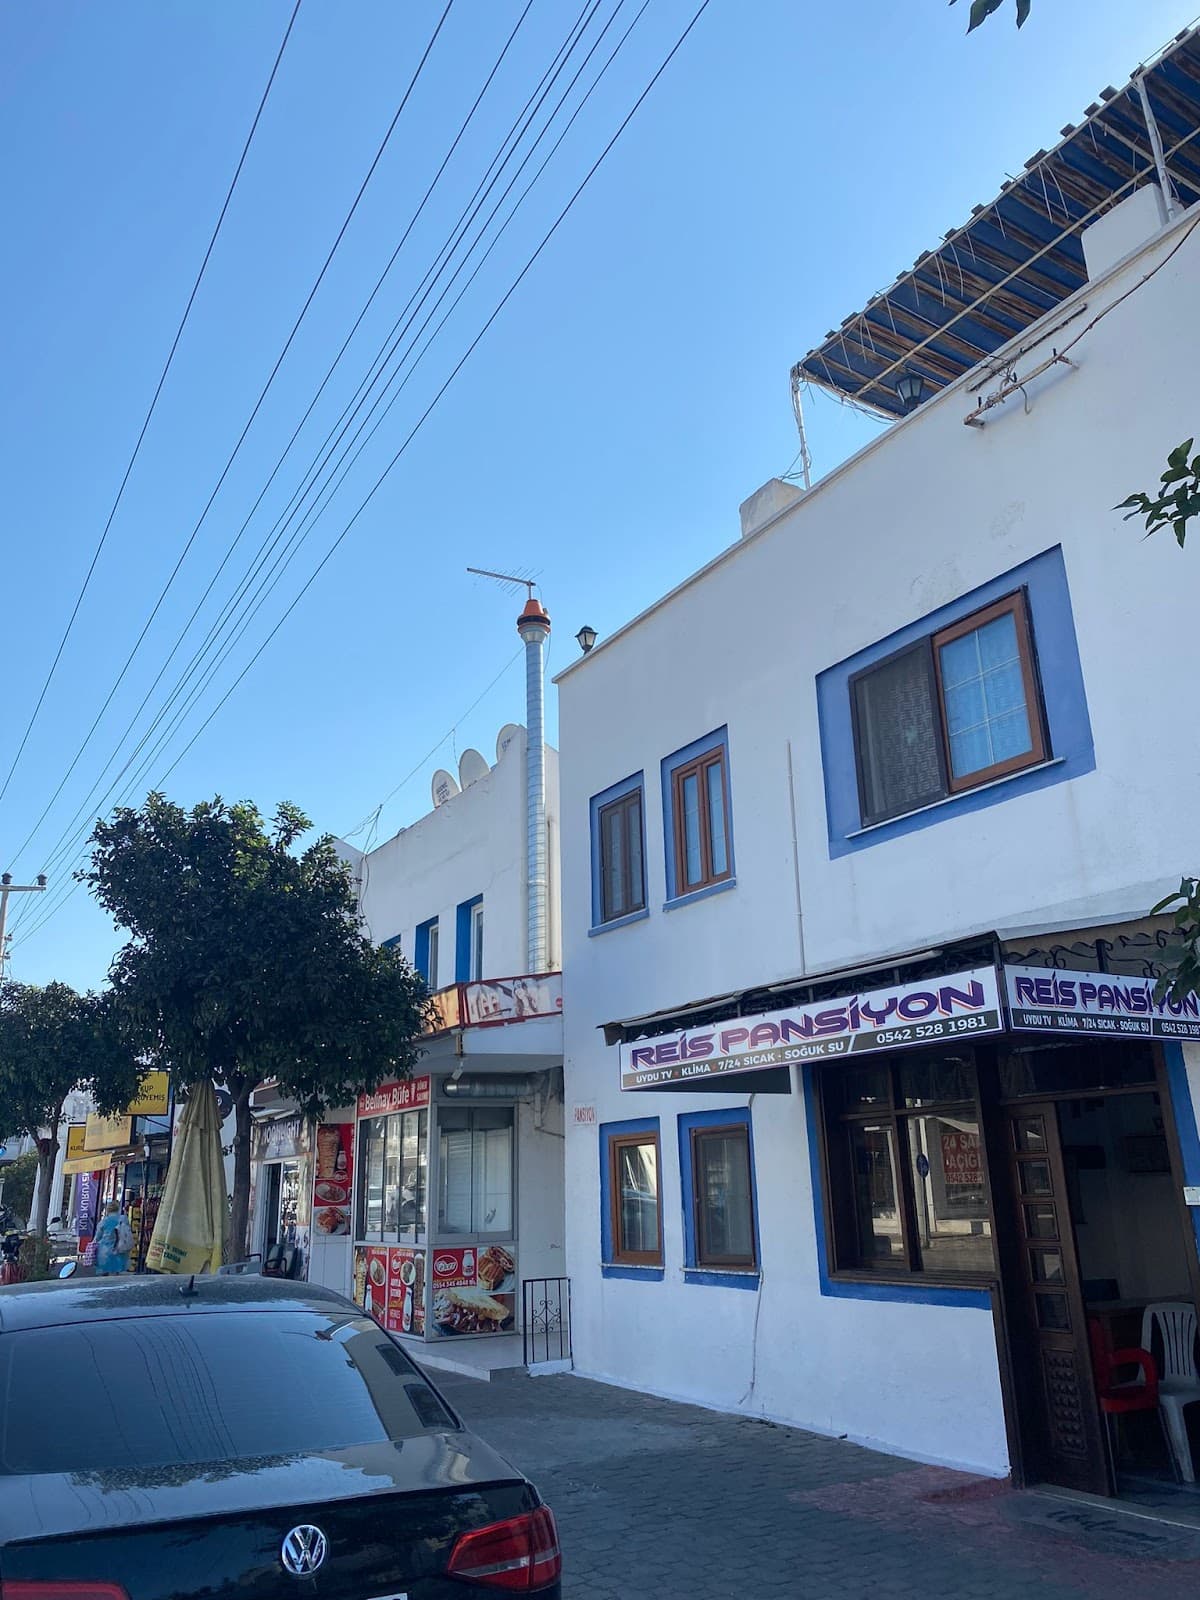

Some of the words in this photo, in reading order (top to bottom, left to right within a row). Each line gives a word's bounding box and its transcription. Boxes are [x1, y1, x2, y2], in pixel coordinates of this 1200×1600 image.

[1015, 970, 1077, 1008] REİS
[630, 1032, 716, 1071] REİS
[720, 979, 985, 1056] PANSİYON
[876, 1030, 912, 1044] 0542
[916, 1023, 944, 1038] 528
[949, 1015, 988, 1033] 1981
[1023, 1013, 1042, 1025] UYDU
[1042, 1015, 1052, 1026] TV
[1057, 1013, 1079, 1028] KLİMA
[1082, 1017, 1097, 1030] 7/24
[1097, 1019, 1117, 1030] SICAK
[1120, 1018, 1141, 1032] SOĞUK
[1141, 1022, 1150, 1032] SU
[1161, 1022, 1177, 1034] 0542
[1177, 1023, 1188, 1034] 528
[636, 1073, 660, 1084] UYDU
[661, 1070, 673, 1080] TV
[681, 1063, 711, 1077] KLİMA
[718, 1059, 741, 1071] 7/24
[743, 1052, 776, 1066] SICAK
[784, 1043, 826, 1060] SOĞUK
[828, 1041, 845, 1053] SU
[392, 1084, 410, 1106] Büfe
